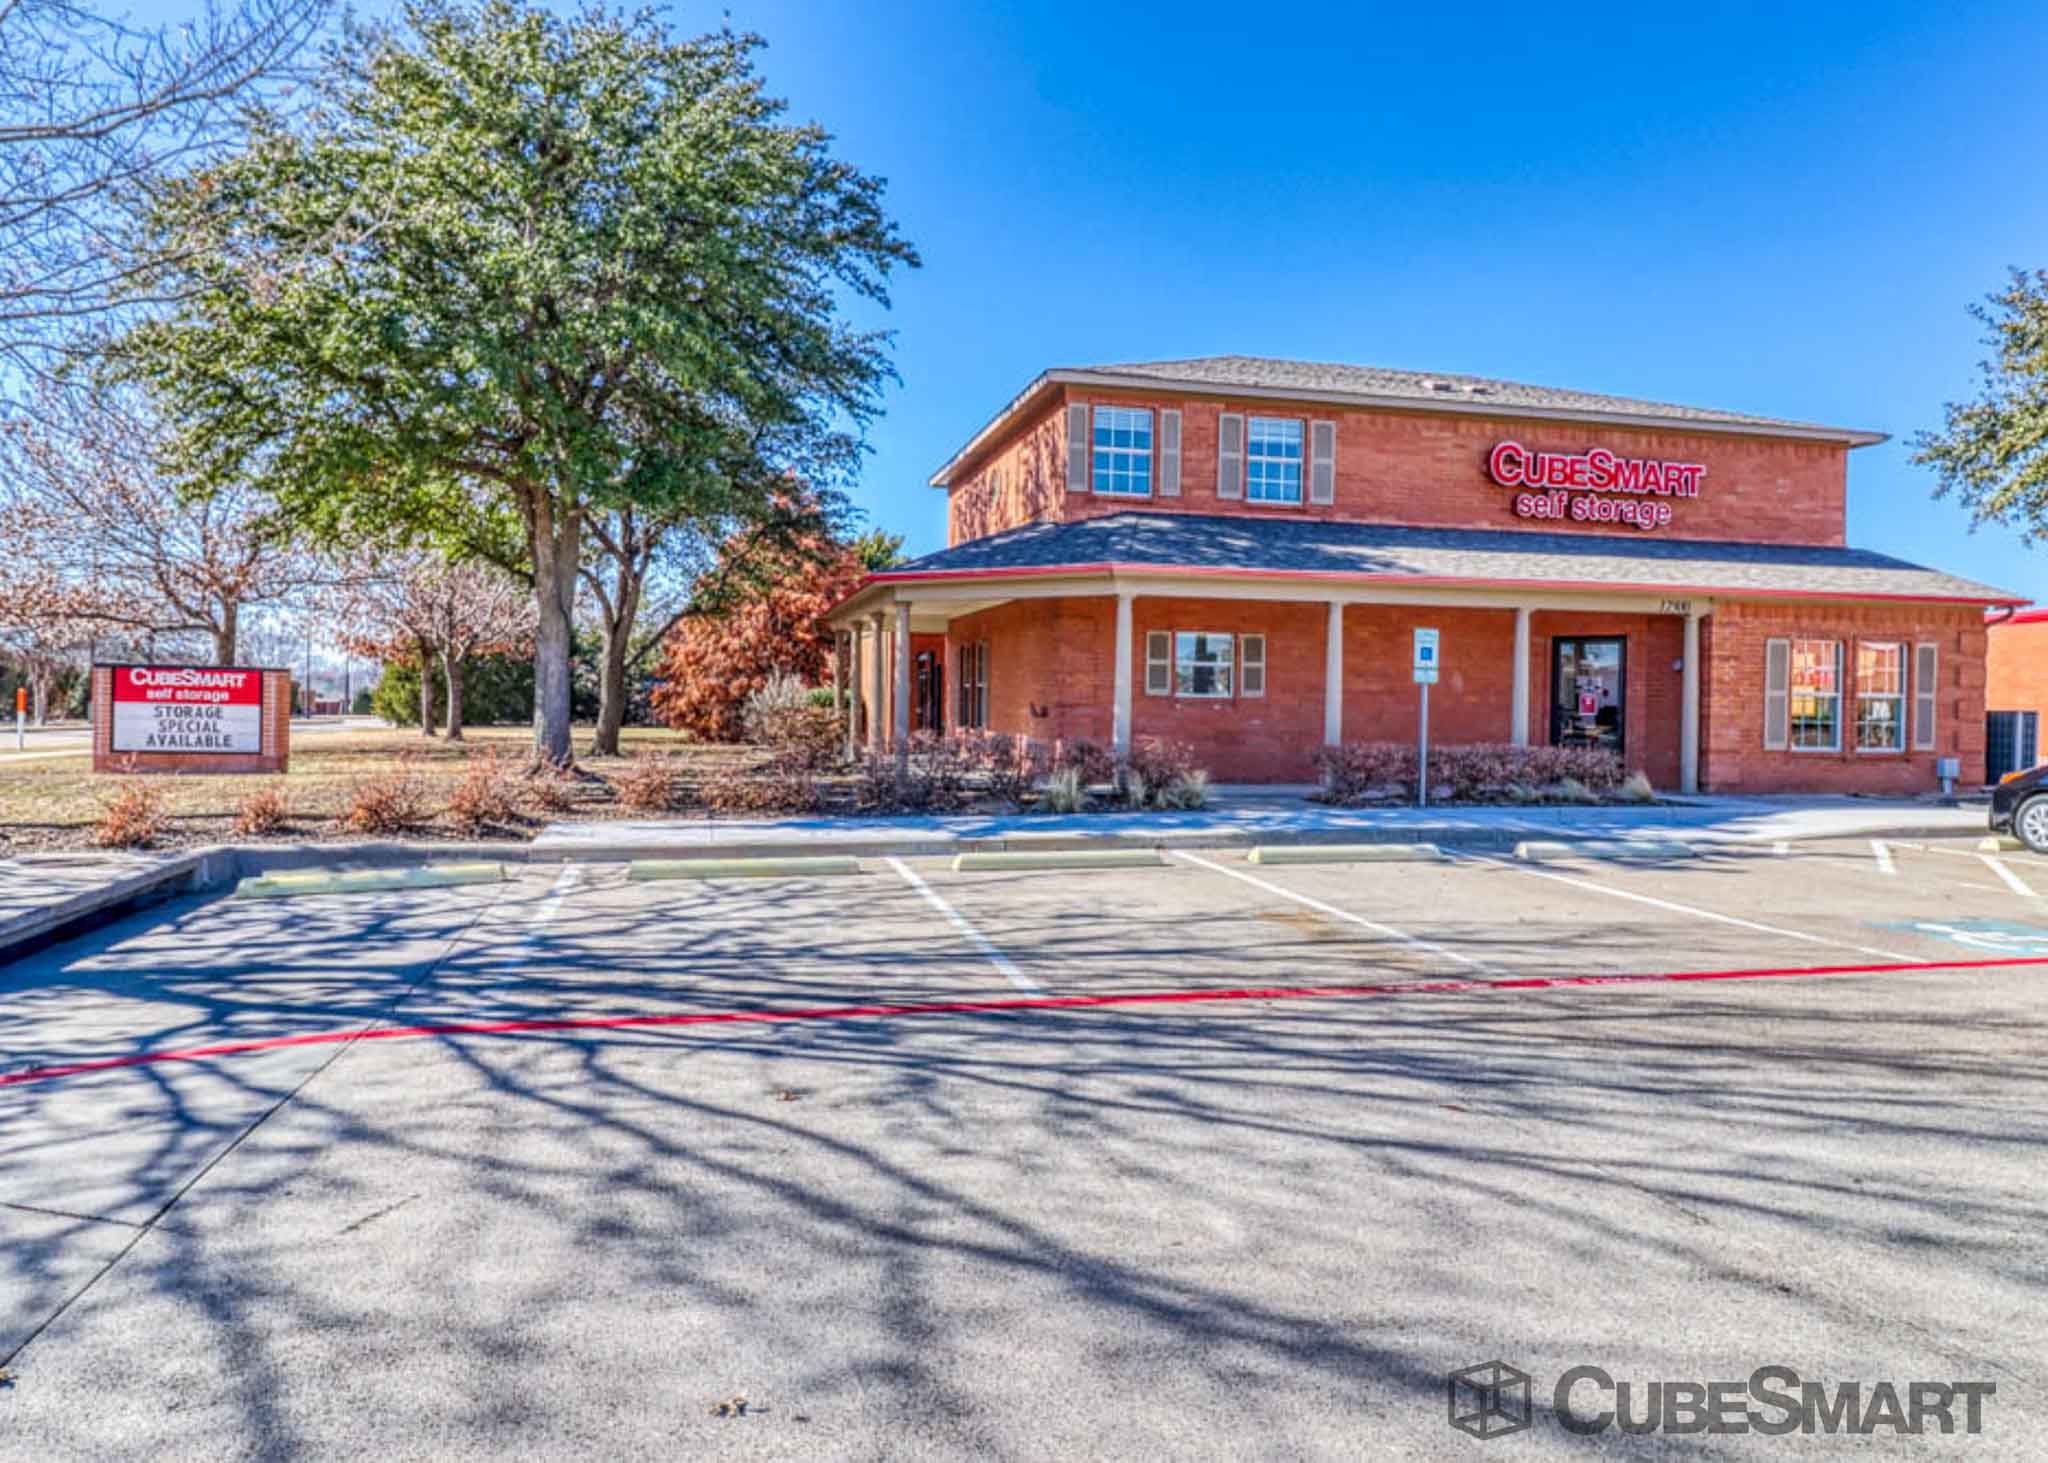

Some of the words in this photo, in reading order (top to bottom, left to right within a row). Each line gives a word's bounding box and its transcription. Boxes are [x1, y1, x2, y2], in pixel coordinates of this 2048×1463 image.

[1516, 491, 1568, 518] self
[1571, 494, 1673, 529] storage
[146, 688, 174, 700] self
[175, 689, 230, 702] storage
[153, 705, 224, 719] STORAGE
[157, 720, 221, 733] SPECIAL
[145, 734, 233, 748] AVAILABLE
